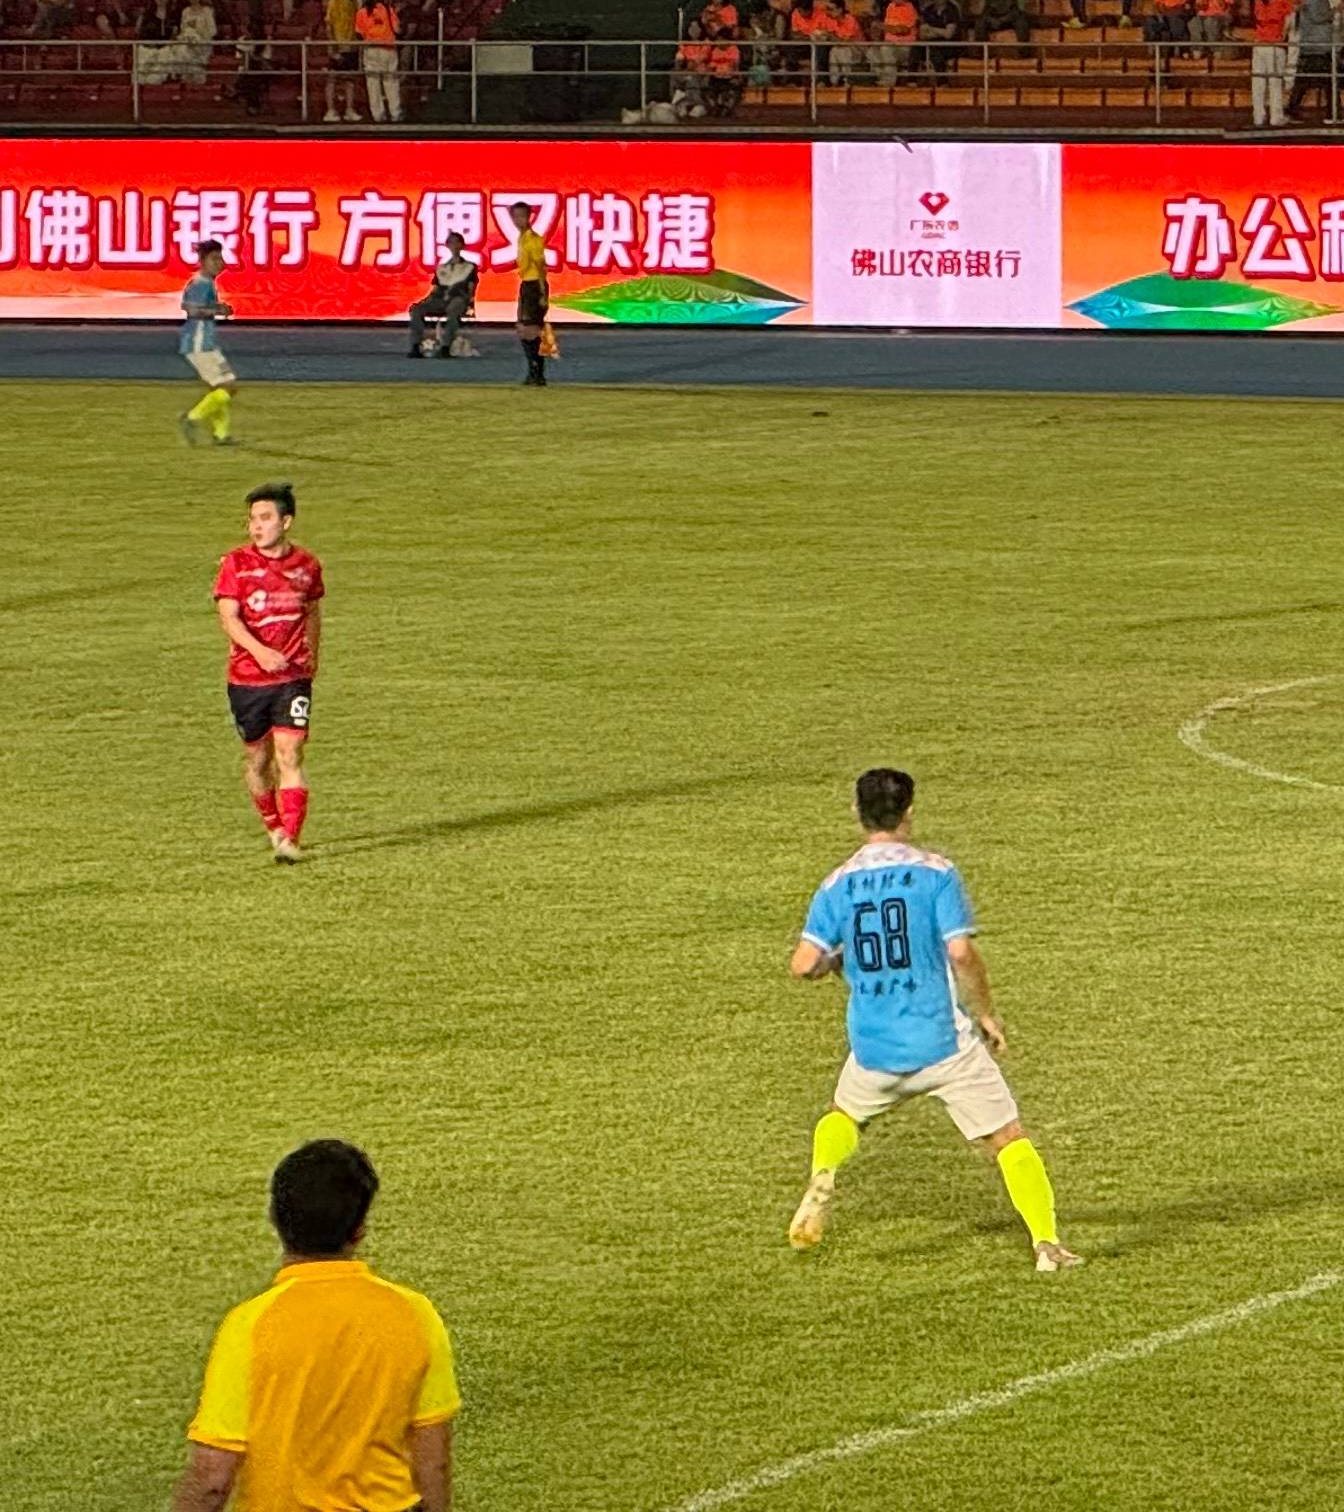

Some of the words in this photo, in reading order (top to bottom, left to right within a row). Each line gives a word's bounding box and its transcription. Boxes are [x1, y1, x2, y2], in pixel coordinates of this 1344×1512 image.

[340, 192, 709, 268] 方便又快捷
[850, 248, 1021, 278] 佛山农商银行
[853, 897, 911, 973] 68
